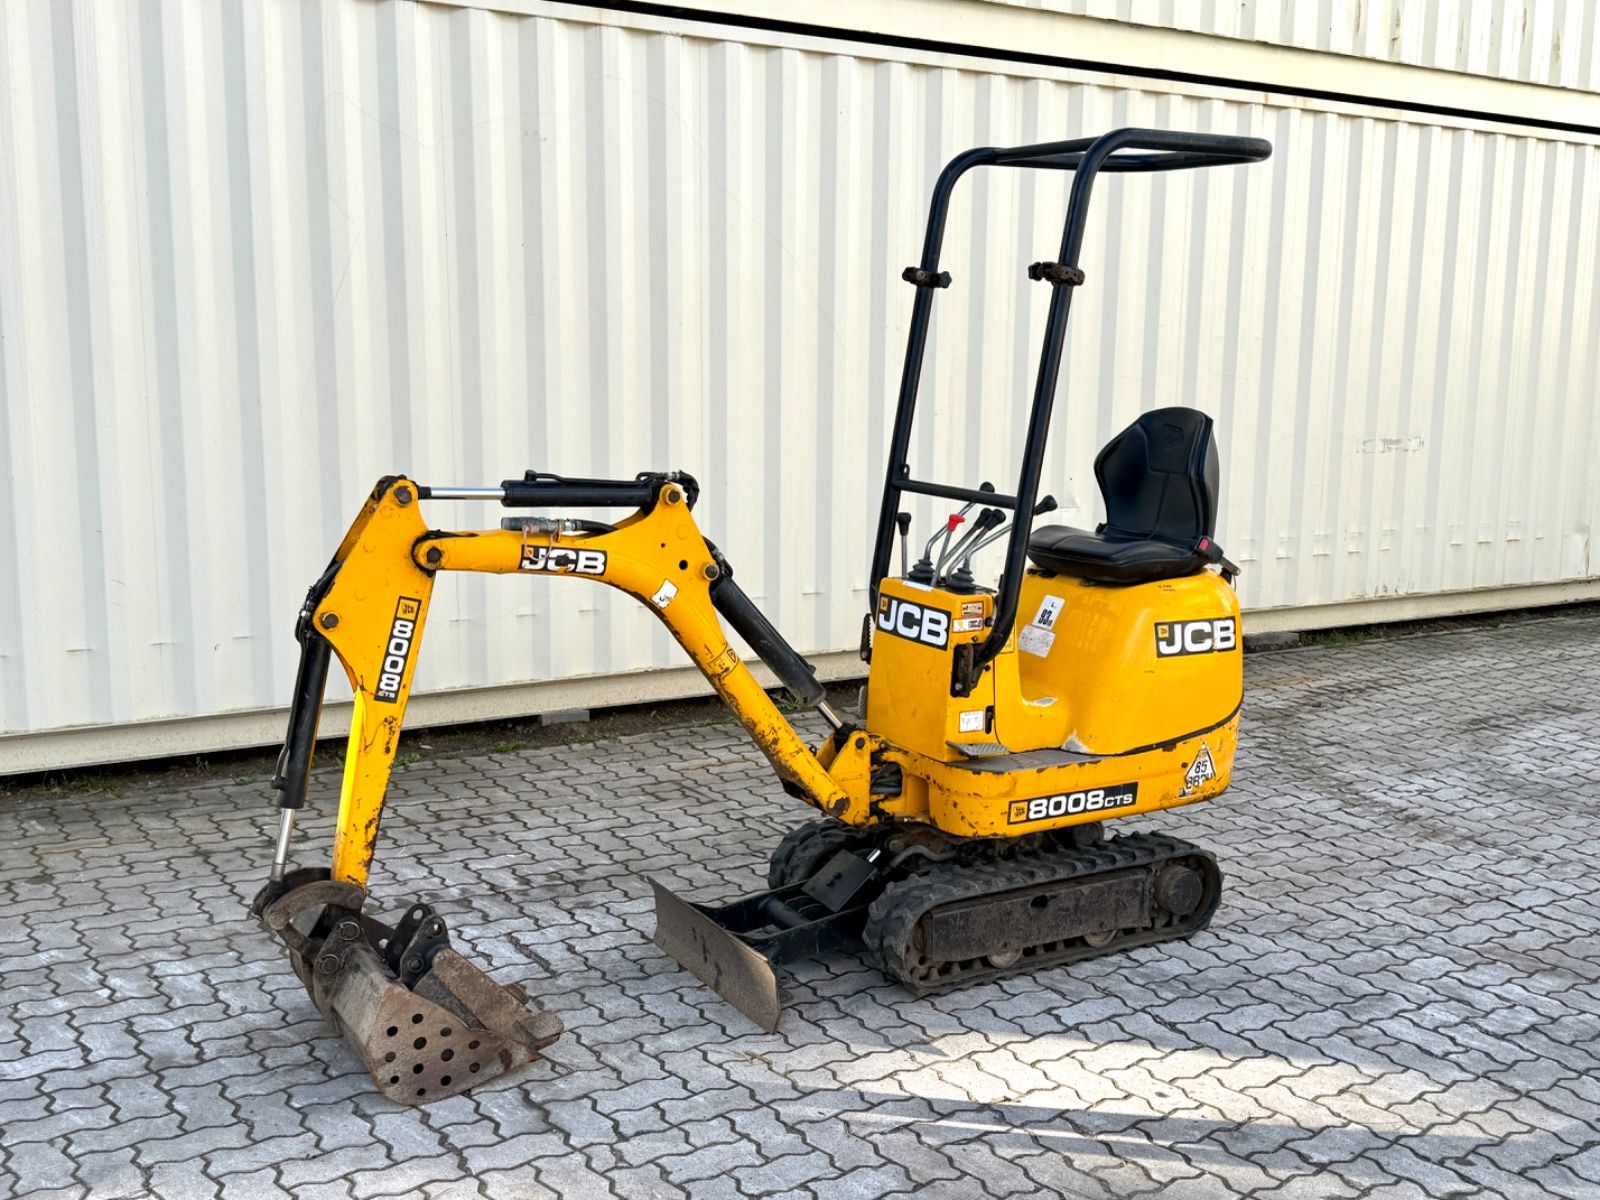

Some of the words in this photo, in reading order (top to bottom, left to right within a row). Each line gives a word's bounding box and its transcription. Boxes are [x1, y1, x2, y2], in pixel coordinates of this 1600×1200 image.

[521, 548, 605, 574] JCB
[879, 599, 949, 647] JCB
[1158, 619, 1236, 655] JCB
[379, 619, 414, 692] 8008
[1194, 761, 1208, 774] 85
